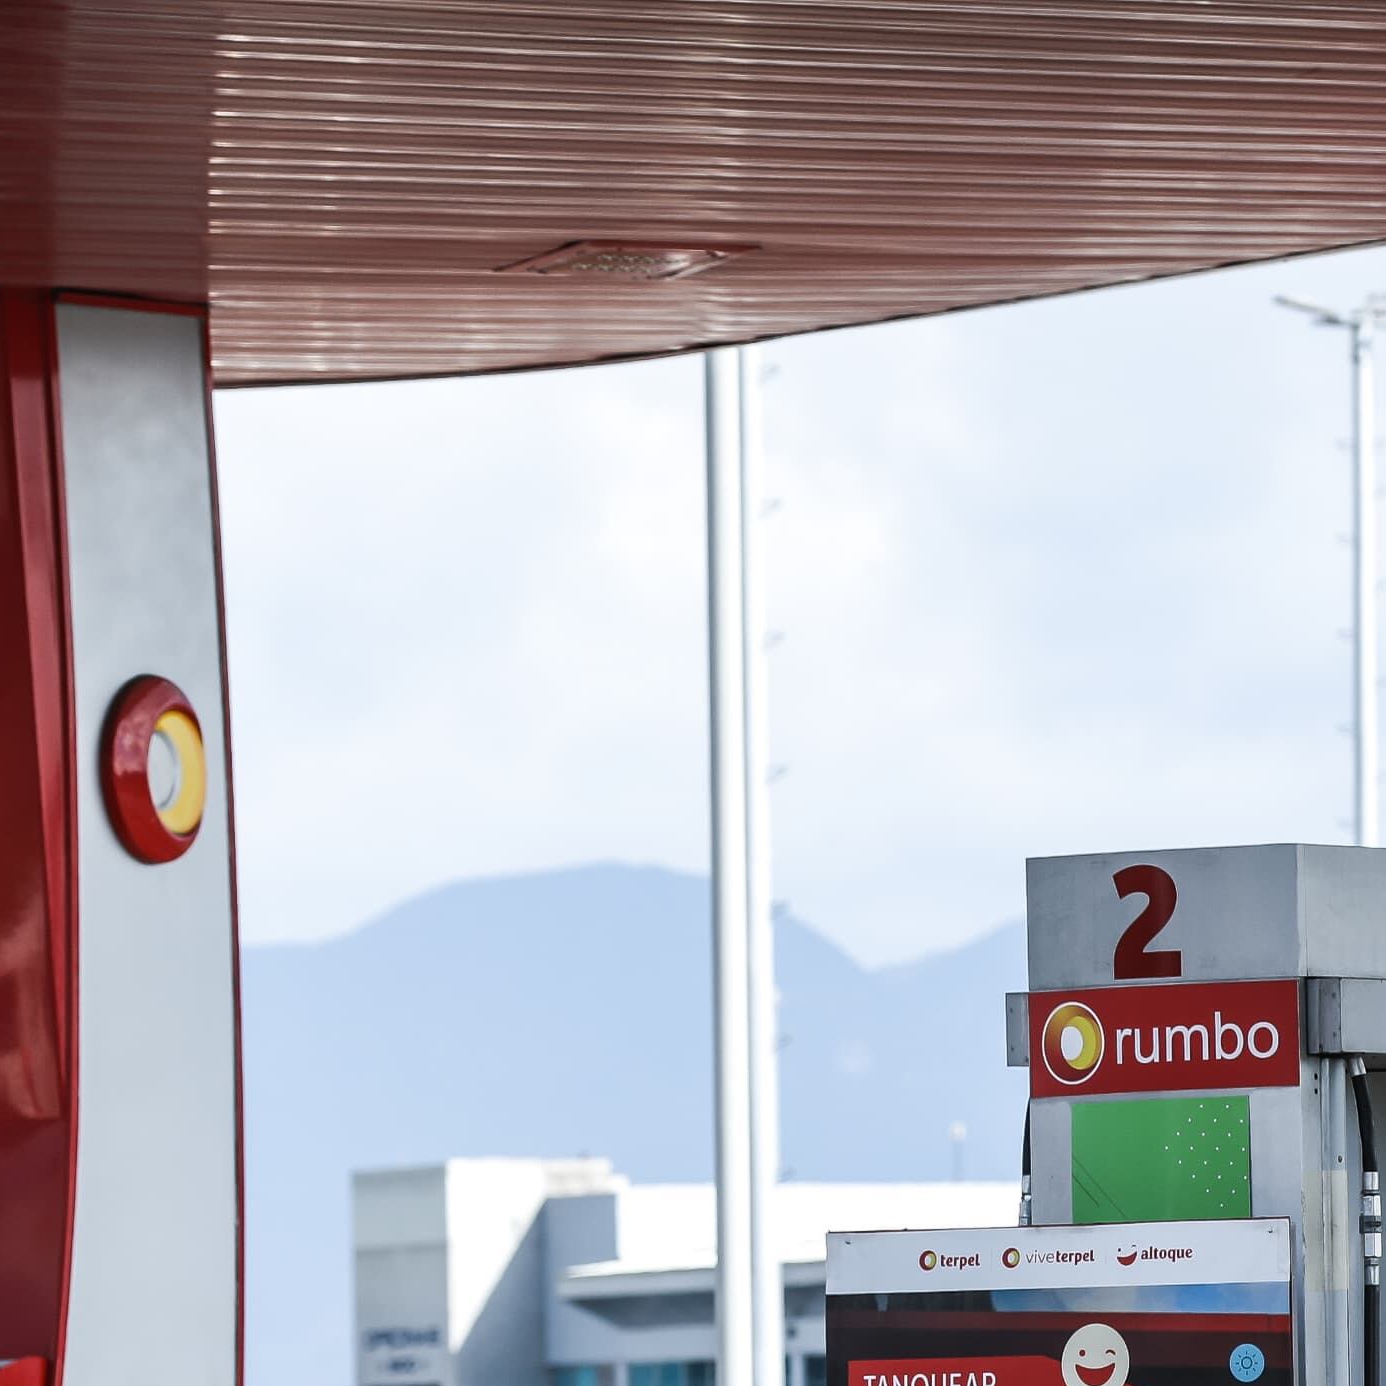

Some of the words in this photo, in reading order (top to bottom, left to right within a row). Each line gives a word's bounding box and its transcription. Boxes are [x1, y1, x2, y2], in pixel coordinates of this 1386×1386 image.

[1113, 864, 1182, 980] 2
[1116, 1011, 1279, 1064] rumbo
[1025, 1250, 1095, 1266] viveterpel
[1141, 1245, 1193, 1262] altoque
[940, 1254, 980, 1271] terpel
